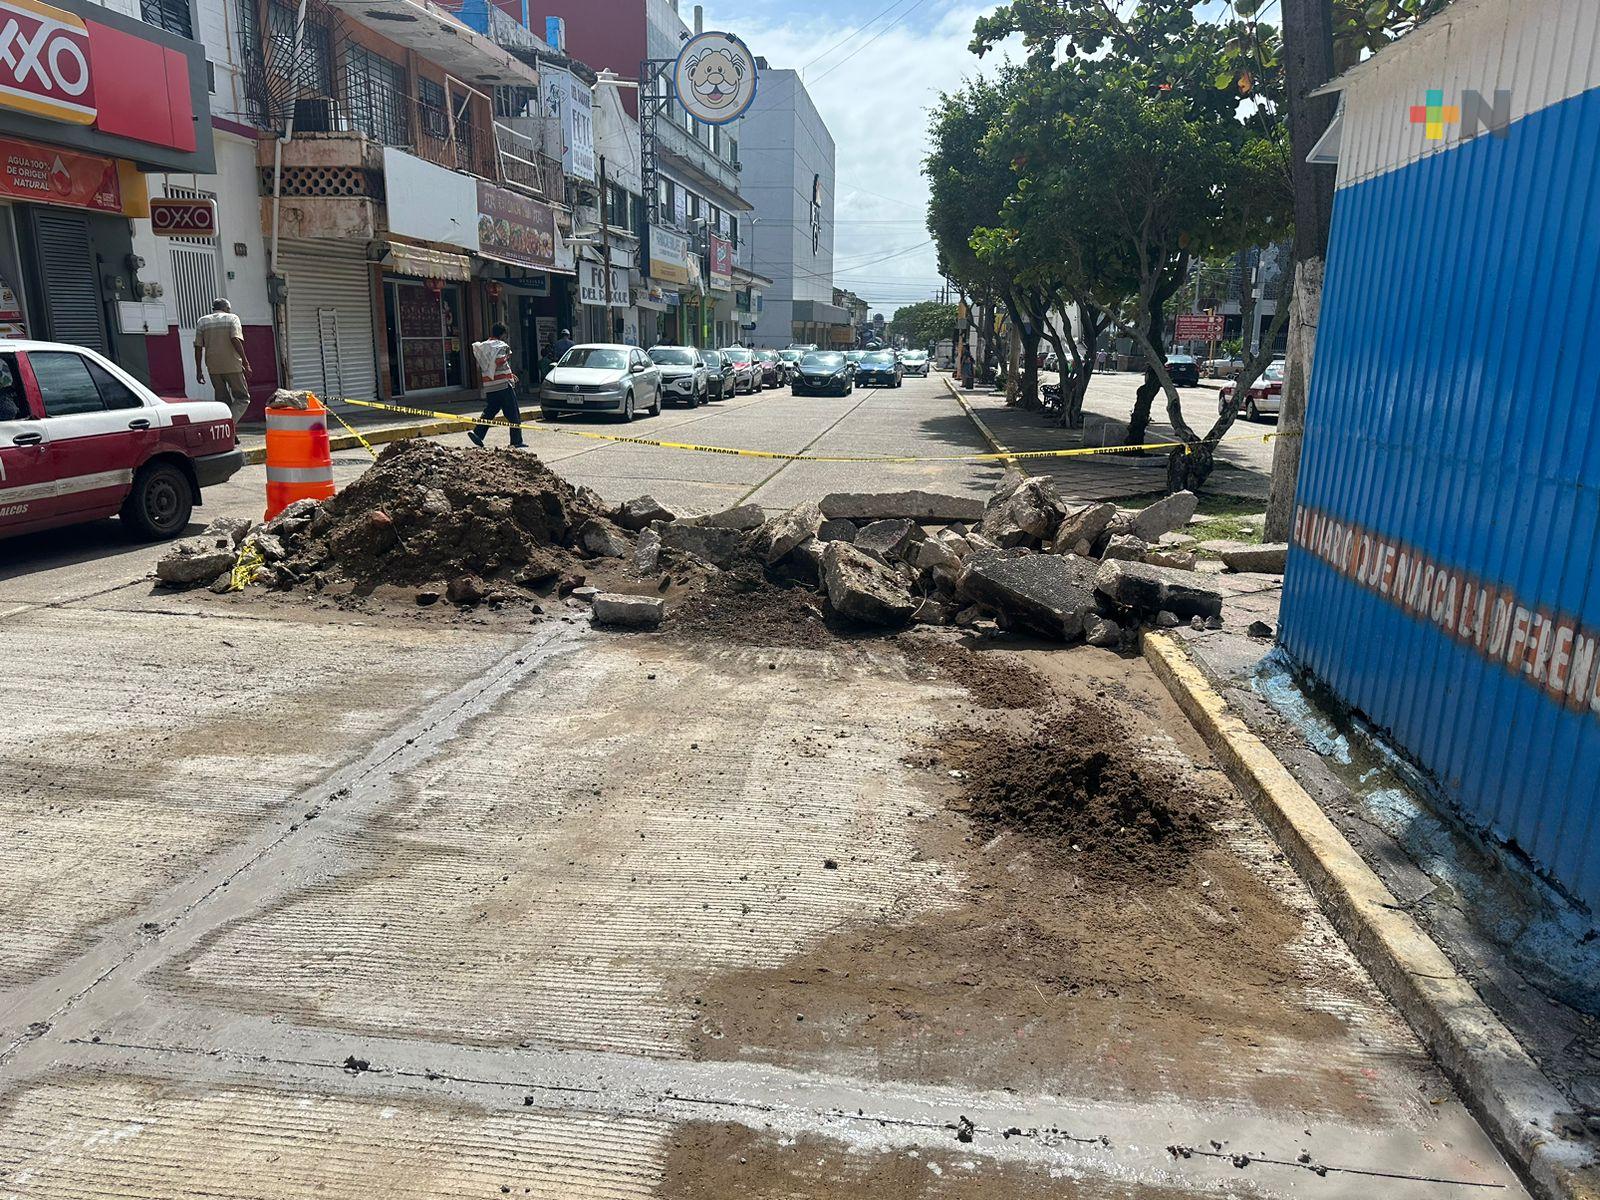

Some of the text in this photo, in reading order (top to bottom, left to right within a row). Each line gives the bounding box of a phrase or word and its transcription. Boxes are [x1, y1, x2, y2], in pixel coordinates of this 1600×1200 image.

[8, 155, 51, 171] AGUA 100%
[6, 165, 47, 180] DE ORIGEN
[13, 178, 50, 191] NATURAL
[154, 206, 210, 229] OXXO
[592, 266, 618, 291] FOO
[582, 287, 597, 300] DEL
[209, 423, 231, 440] 1770
[1293, 504, 1307, 548] EL
[1356, 534, 1395, 593] QUE
[1392, 551, 1457, 630] MARCA
[1458, 582, 1487, 646] LA
